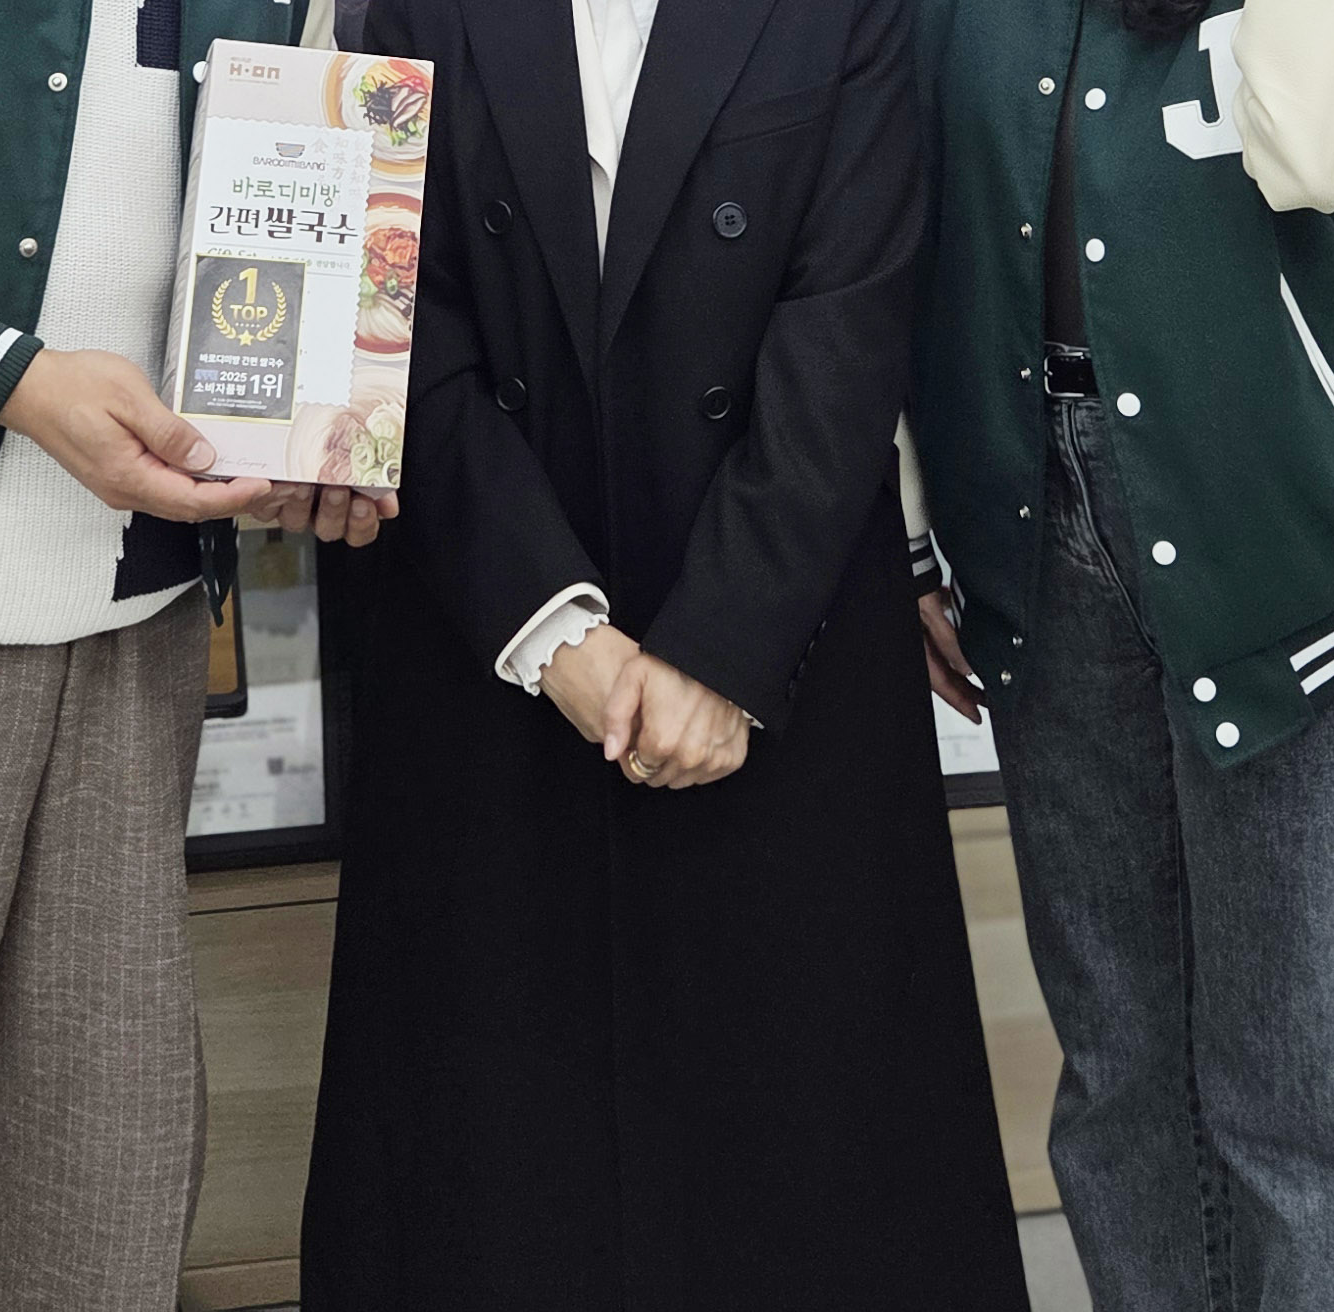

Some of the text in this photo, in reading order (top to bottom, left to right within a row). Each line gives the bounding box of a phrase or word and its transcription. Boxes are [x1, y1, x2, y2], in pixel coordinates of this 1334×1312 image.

[232, 176, 340, 208] 바로디미방
[208, 205, 359, 245] 간편 쌀국수
[239, 267, 258, 304] 1
[230, 304, 268, 322] TOP
[199, 353, 241, 366] 바로디미방
[259, 357, 285, 369] 쌀국수
[219, 370, 248, 383] 2025
[249, 373, 284, 399] 1위
